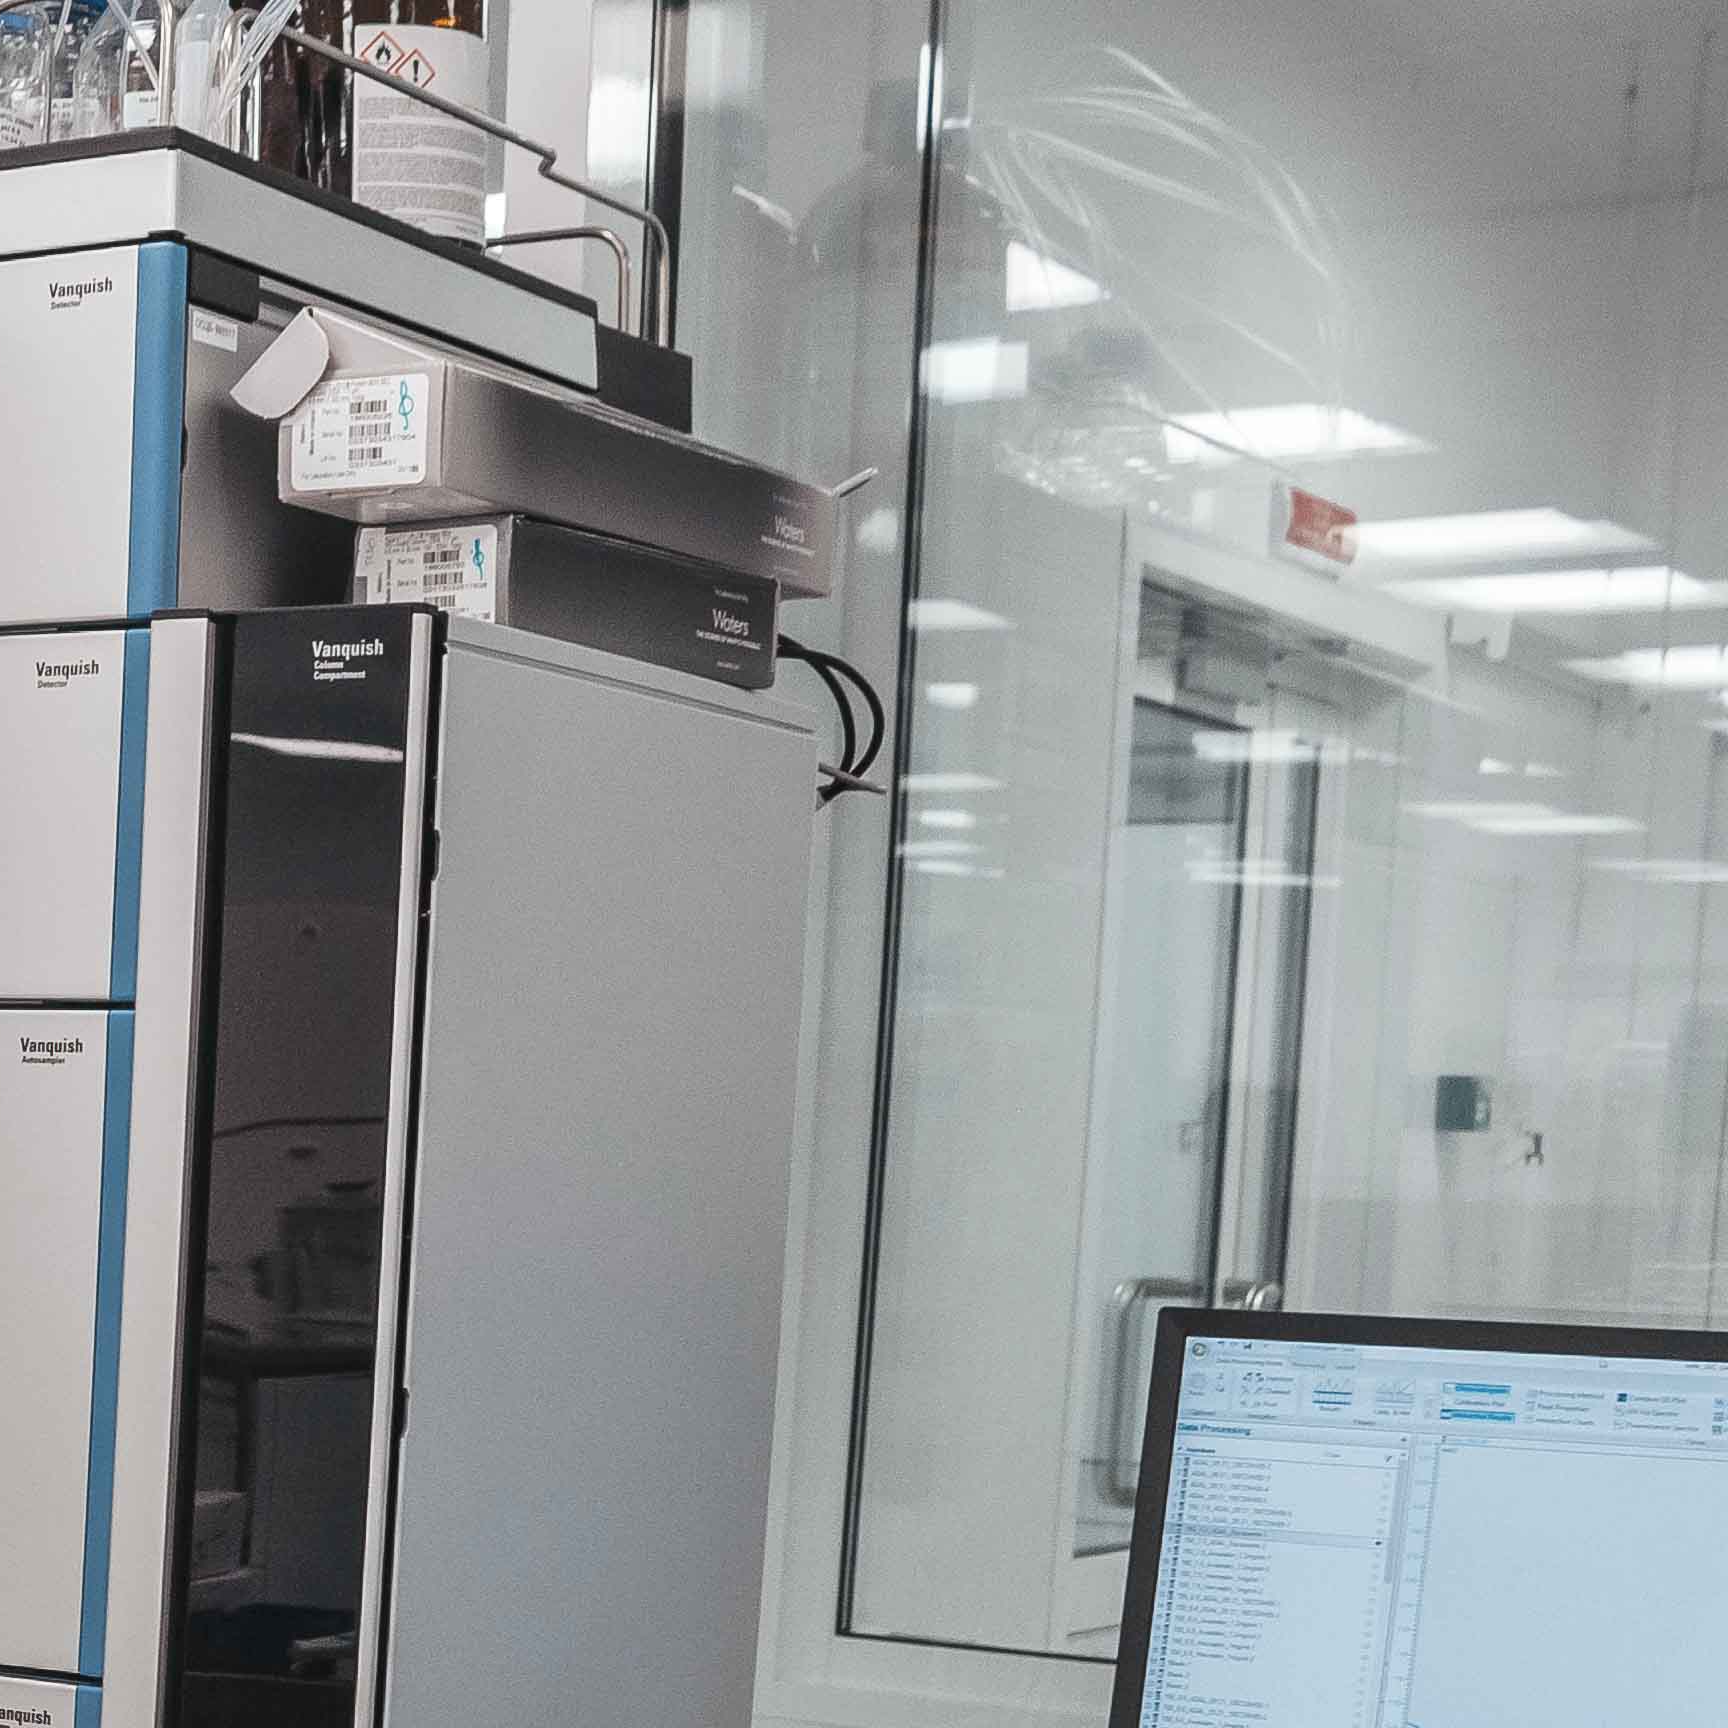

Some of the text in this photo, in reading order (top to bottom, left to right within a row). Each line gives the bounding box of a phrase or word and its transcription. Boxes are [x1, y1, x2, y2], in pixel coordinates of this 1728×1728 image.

[49, 277, 113, 299] Vanquish
[51, 300, 81, 310] Detector
[712, 608, 750, 637] Waters
[312, 638, 384, 661] Vanquish
[36, 659, 100, 681] Vanquish
[314, 660, 344, 670] Column
[314, 670, 366, 683] Compartment
[20, 1037, 84, 1057] Vanquish
[1200, 1424, 1251, 1436] Processing
